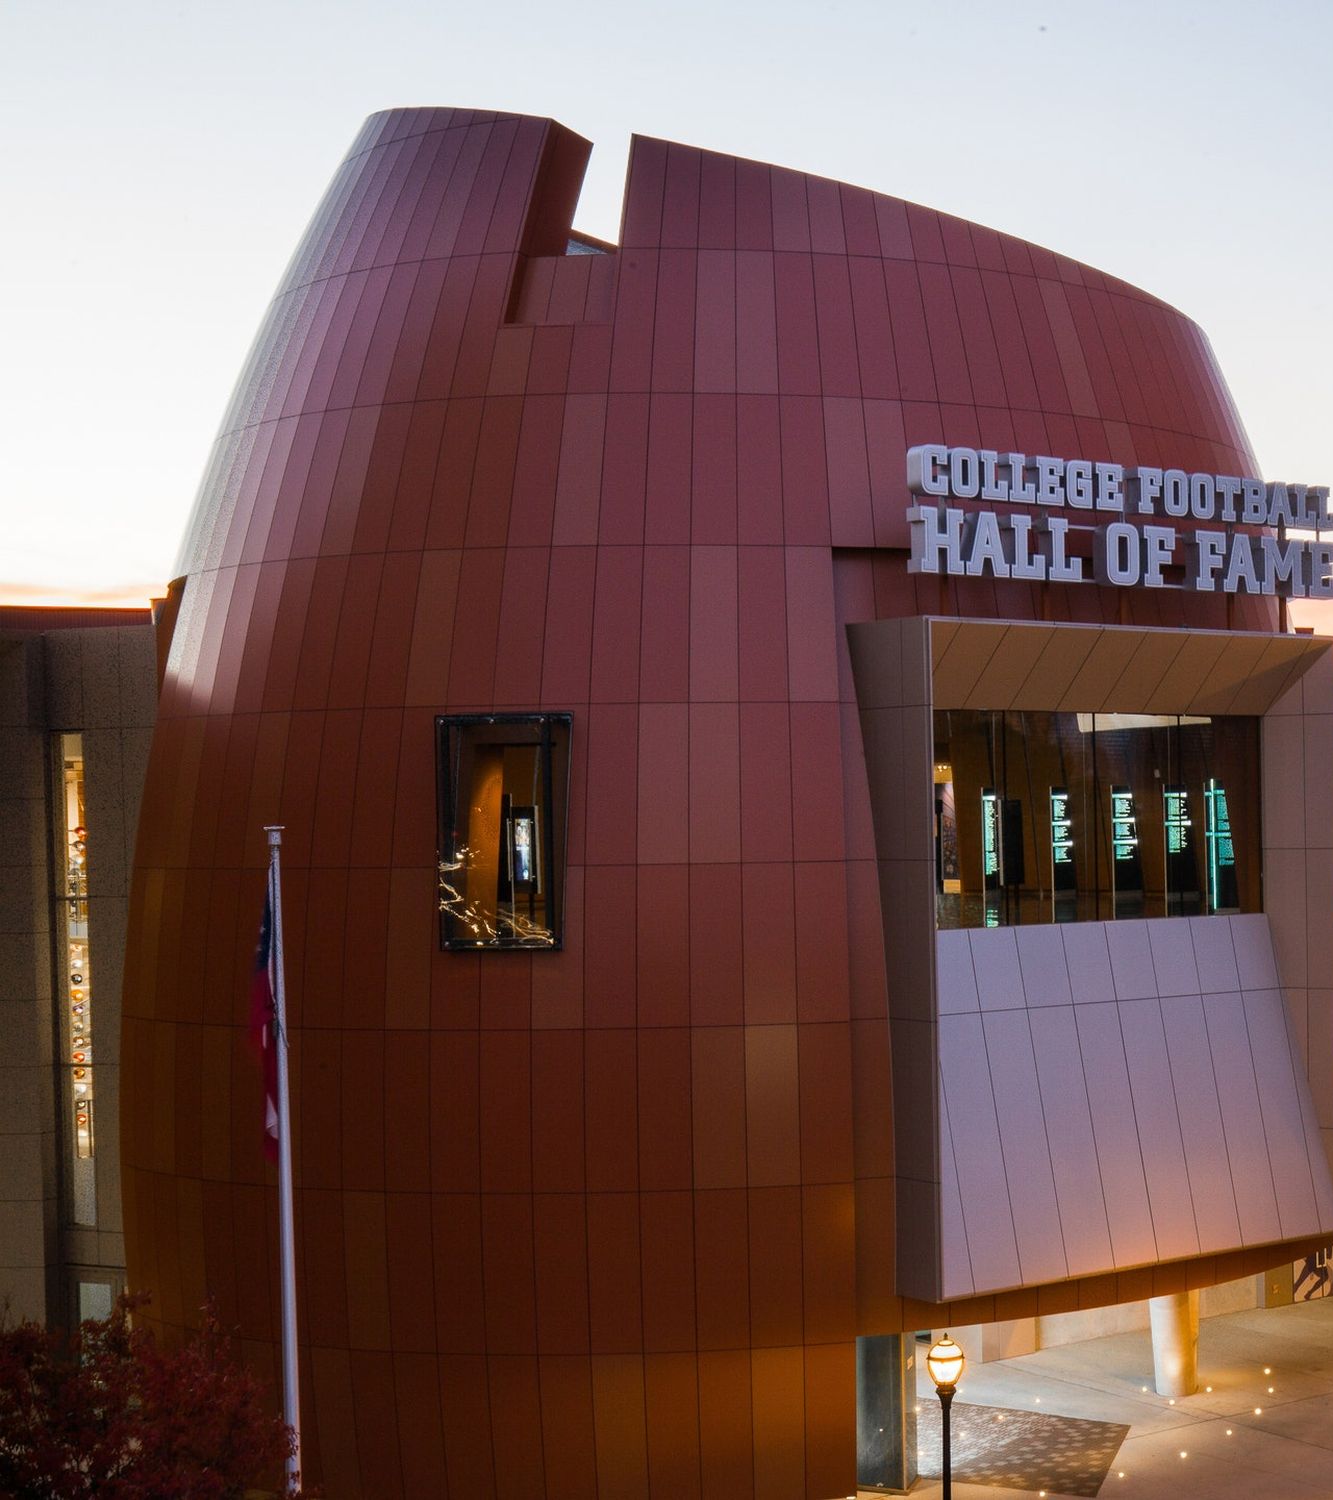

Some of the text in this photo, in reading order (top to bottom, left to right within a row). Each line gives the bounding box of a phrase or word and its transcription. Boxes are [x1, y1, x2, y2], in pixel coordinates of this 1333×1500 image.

[914, 444, 1123, 512] COLLEGE
[916, 505, 1082, 581] HALL
[1103, 523, 1176, 587] OF
